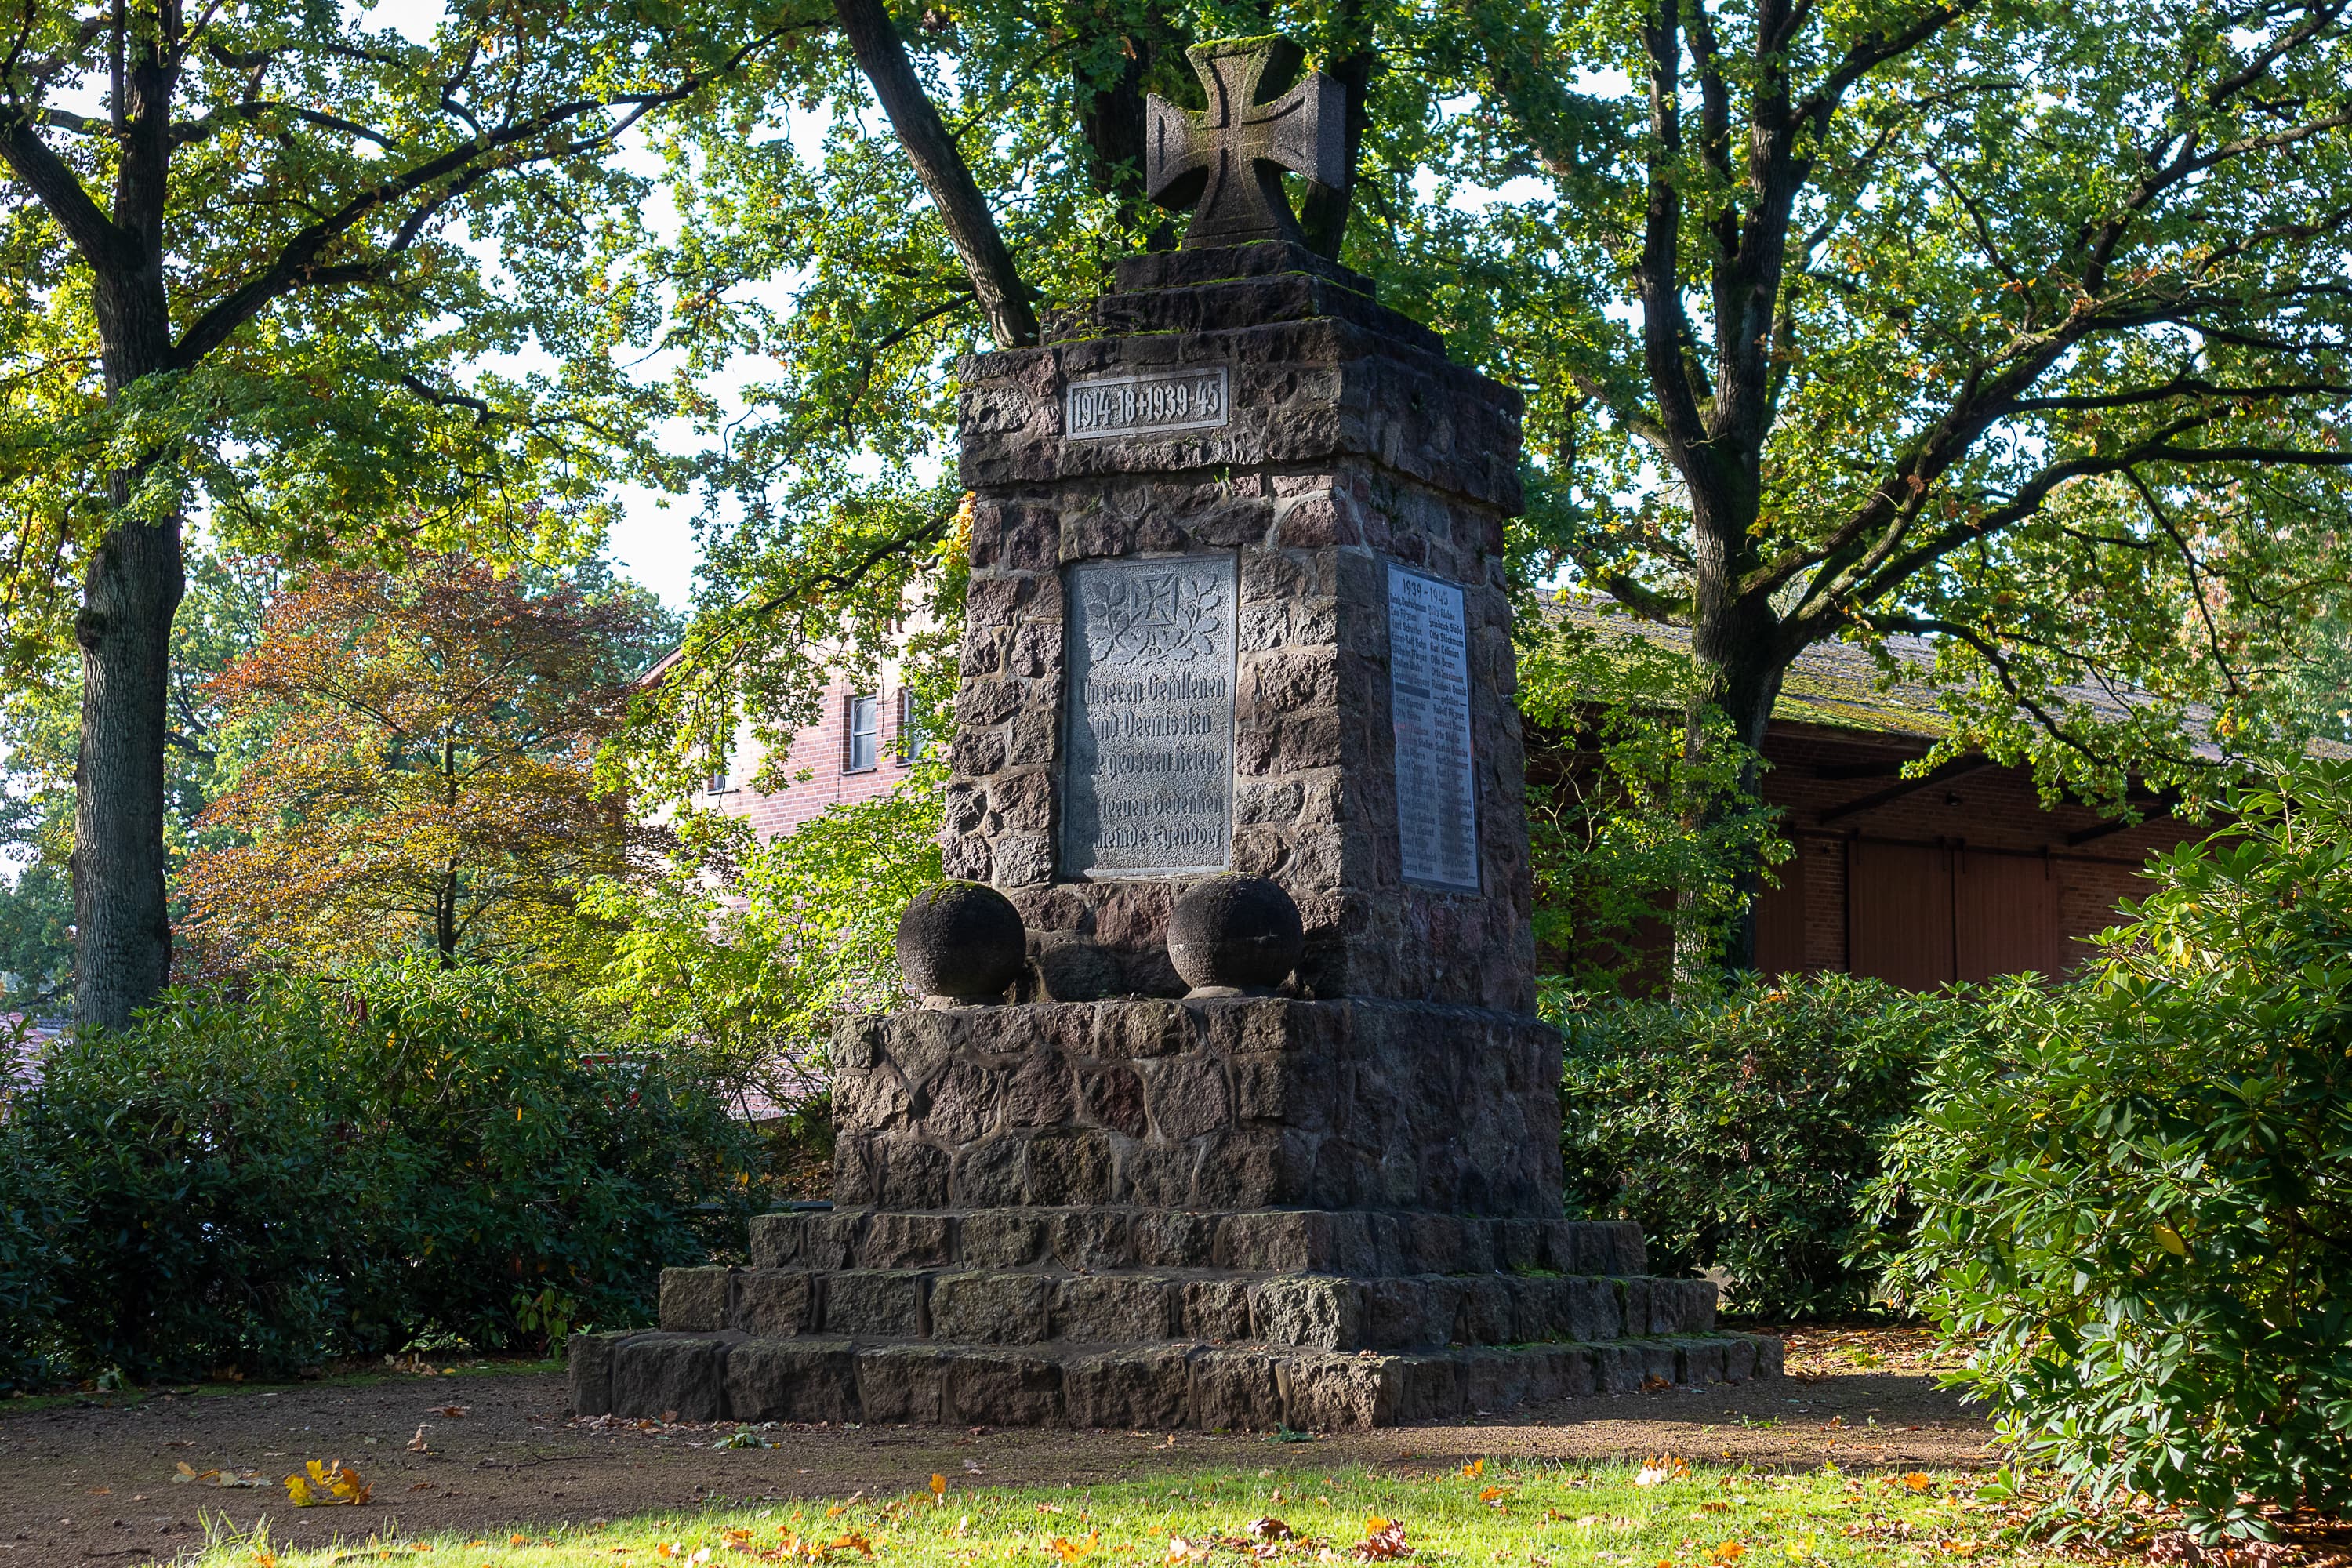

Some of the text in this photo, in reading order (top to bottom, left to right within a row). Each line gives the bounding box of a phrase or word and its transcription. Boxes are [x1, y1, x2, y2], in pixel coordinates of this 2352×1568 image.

[1403, 577, 1421, 597] 1939
[1429, 586, 1449, 606] 1945
[1147, 670, 1226, 702] Gefallenen
[1123, 707, 1211, 738] Vermissten
[1107, 752, 1171, 779] grossen
[1174, 746, 1225, 775] Kriege
[1152, 789, 1225, 816] Gedenken
[1092, 821, 1223, 851] meinde Eyendorf
